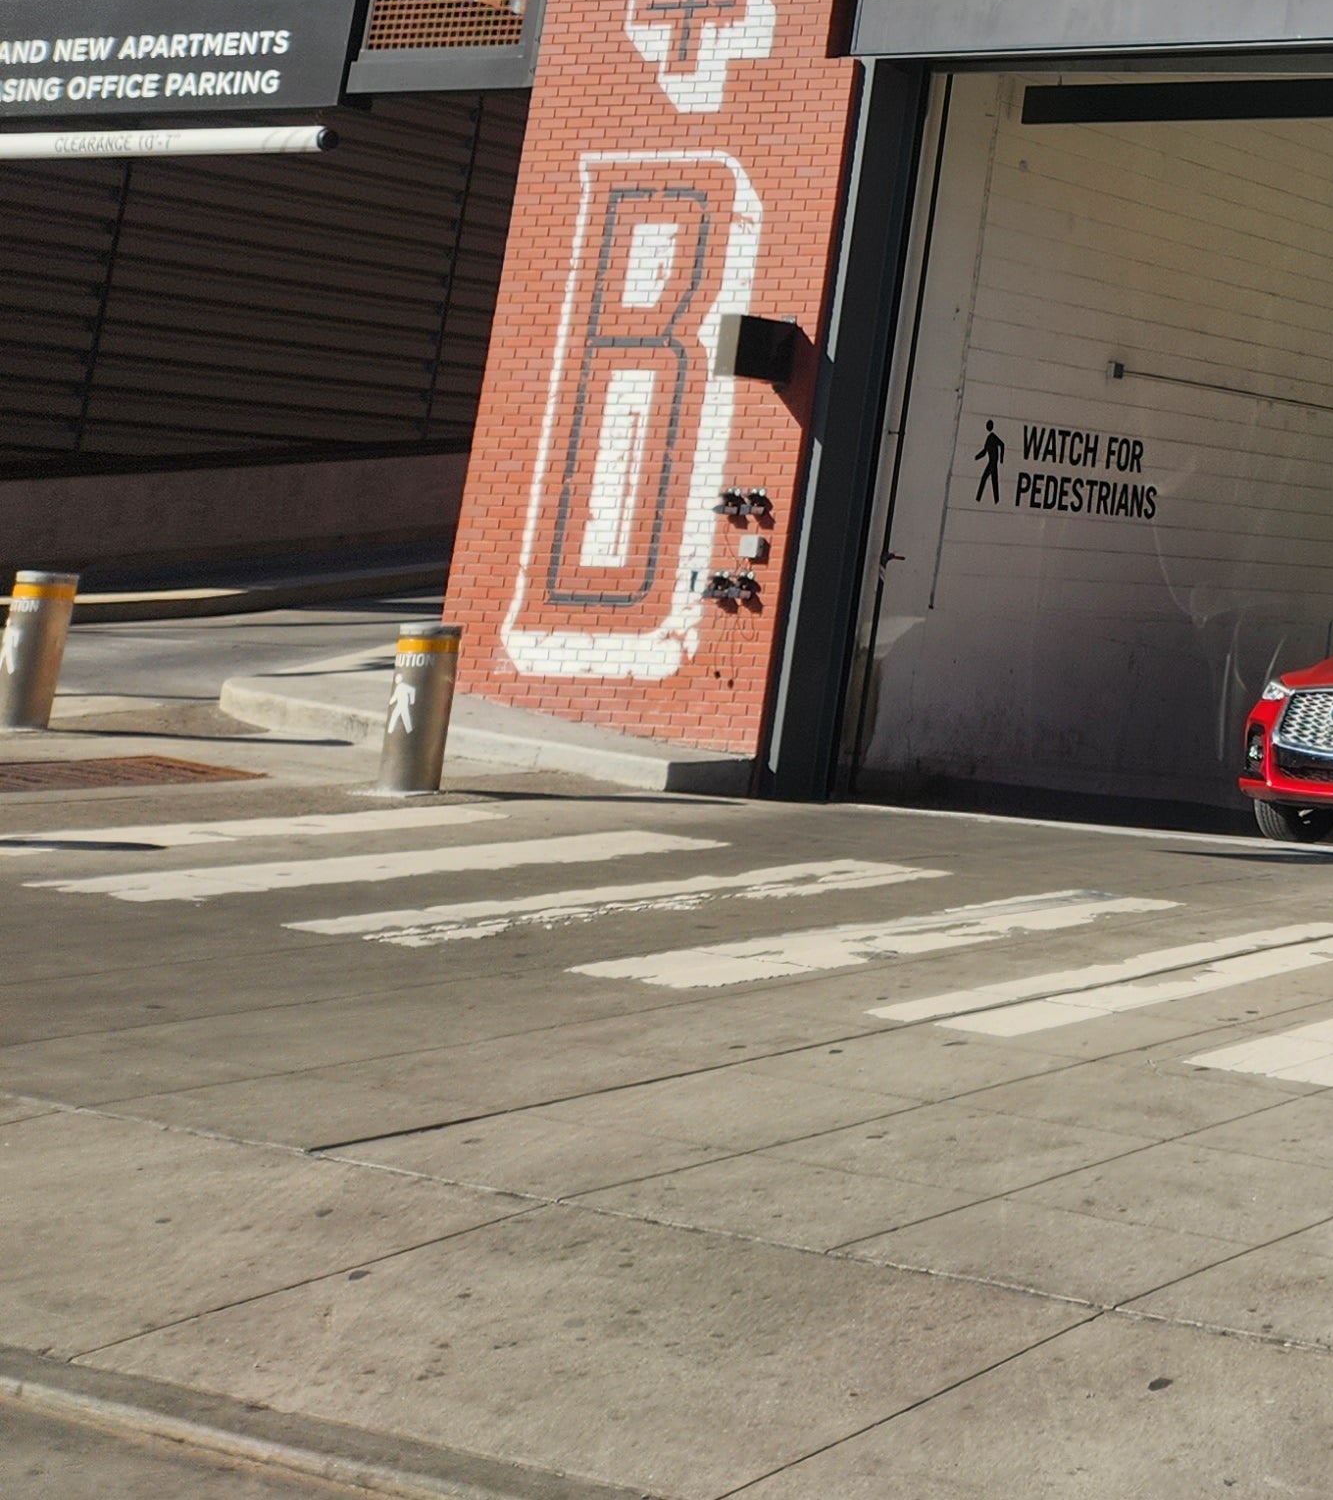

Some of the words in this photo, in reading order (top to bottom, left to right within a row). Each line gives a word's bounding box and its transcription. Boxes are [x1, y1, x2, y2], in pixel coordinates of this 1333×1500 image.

[53, 37, 114, 63] NEW
[118, 30, 290, 60] APARTMENTS
[67, 73, 161, 100] OFFICE
[165, 69, 281, 97] PARKING
[55, 135, 132, 153] CLEARANCE
[1023, 425, 1099, 469] WATCH
[1105, 437, 1144, 474] FOR
[1015, 472, 1158, 520] PEDESTRIANS
